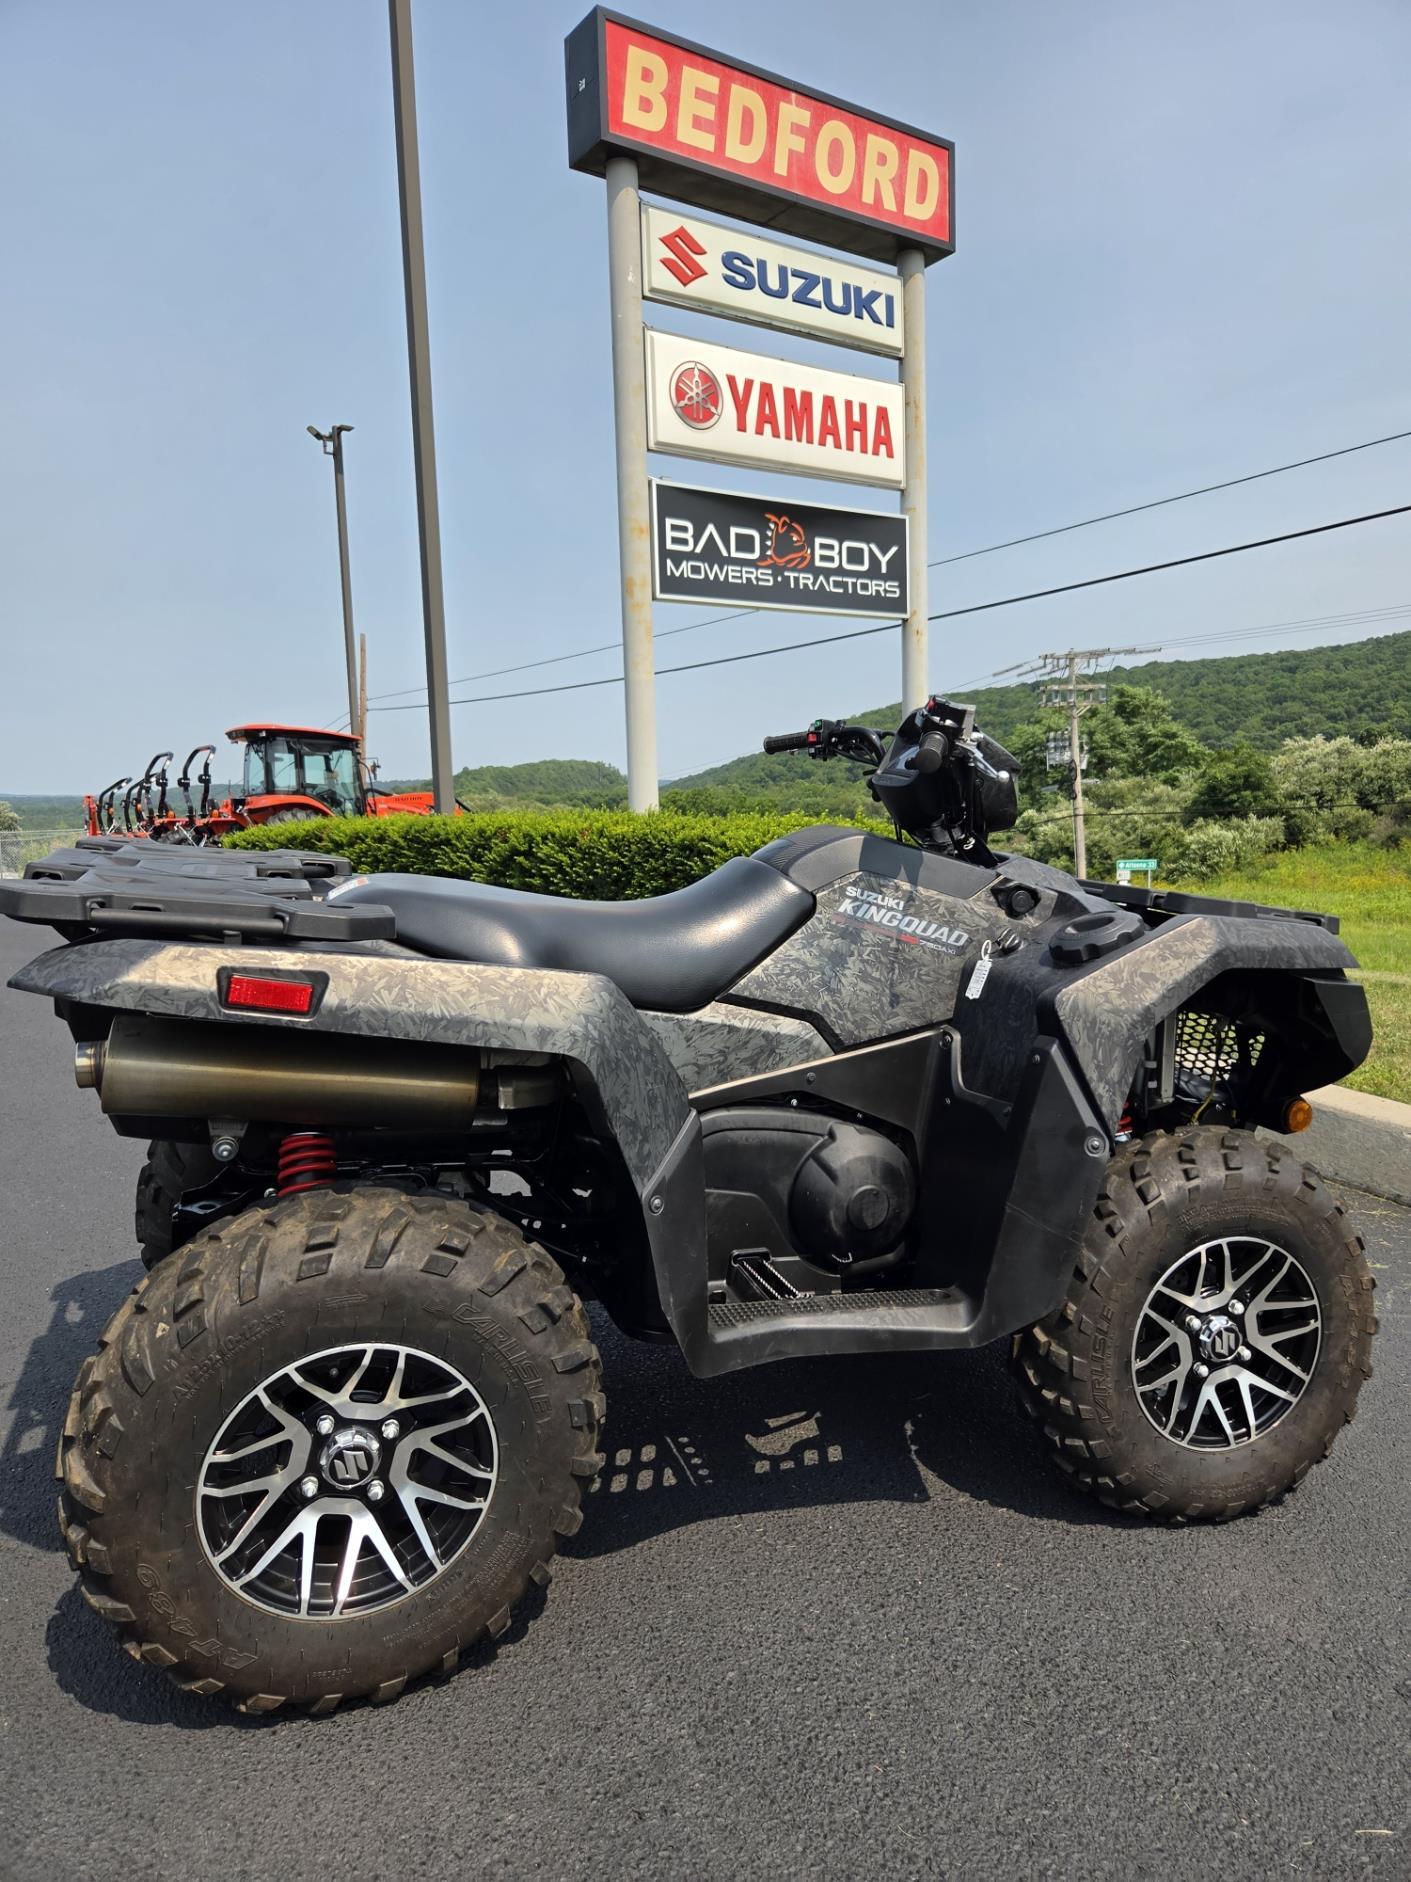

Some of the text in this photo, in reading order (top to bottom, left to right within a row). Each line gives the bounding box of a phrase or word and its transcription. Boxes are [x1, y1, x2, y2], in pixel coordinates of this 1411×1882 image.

[621, 44, 941, 221] BEDFORD
[721, 250, 896, 329] SUZUKI
[725, 373, 895, 459] YAMAHA
[664, 516, 899, 574] BAD BOY
[666, 558, 900, 598] MOWERS TRACTORS
[837, 899, 970, 948] KINGQUAD
[845, 885, 905, 911] SUZUKI
[450, 1302, 553, 1413] CARLISLE
